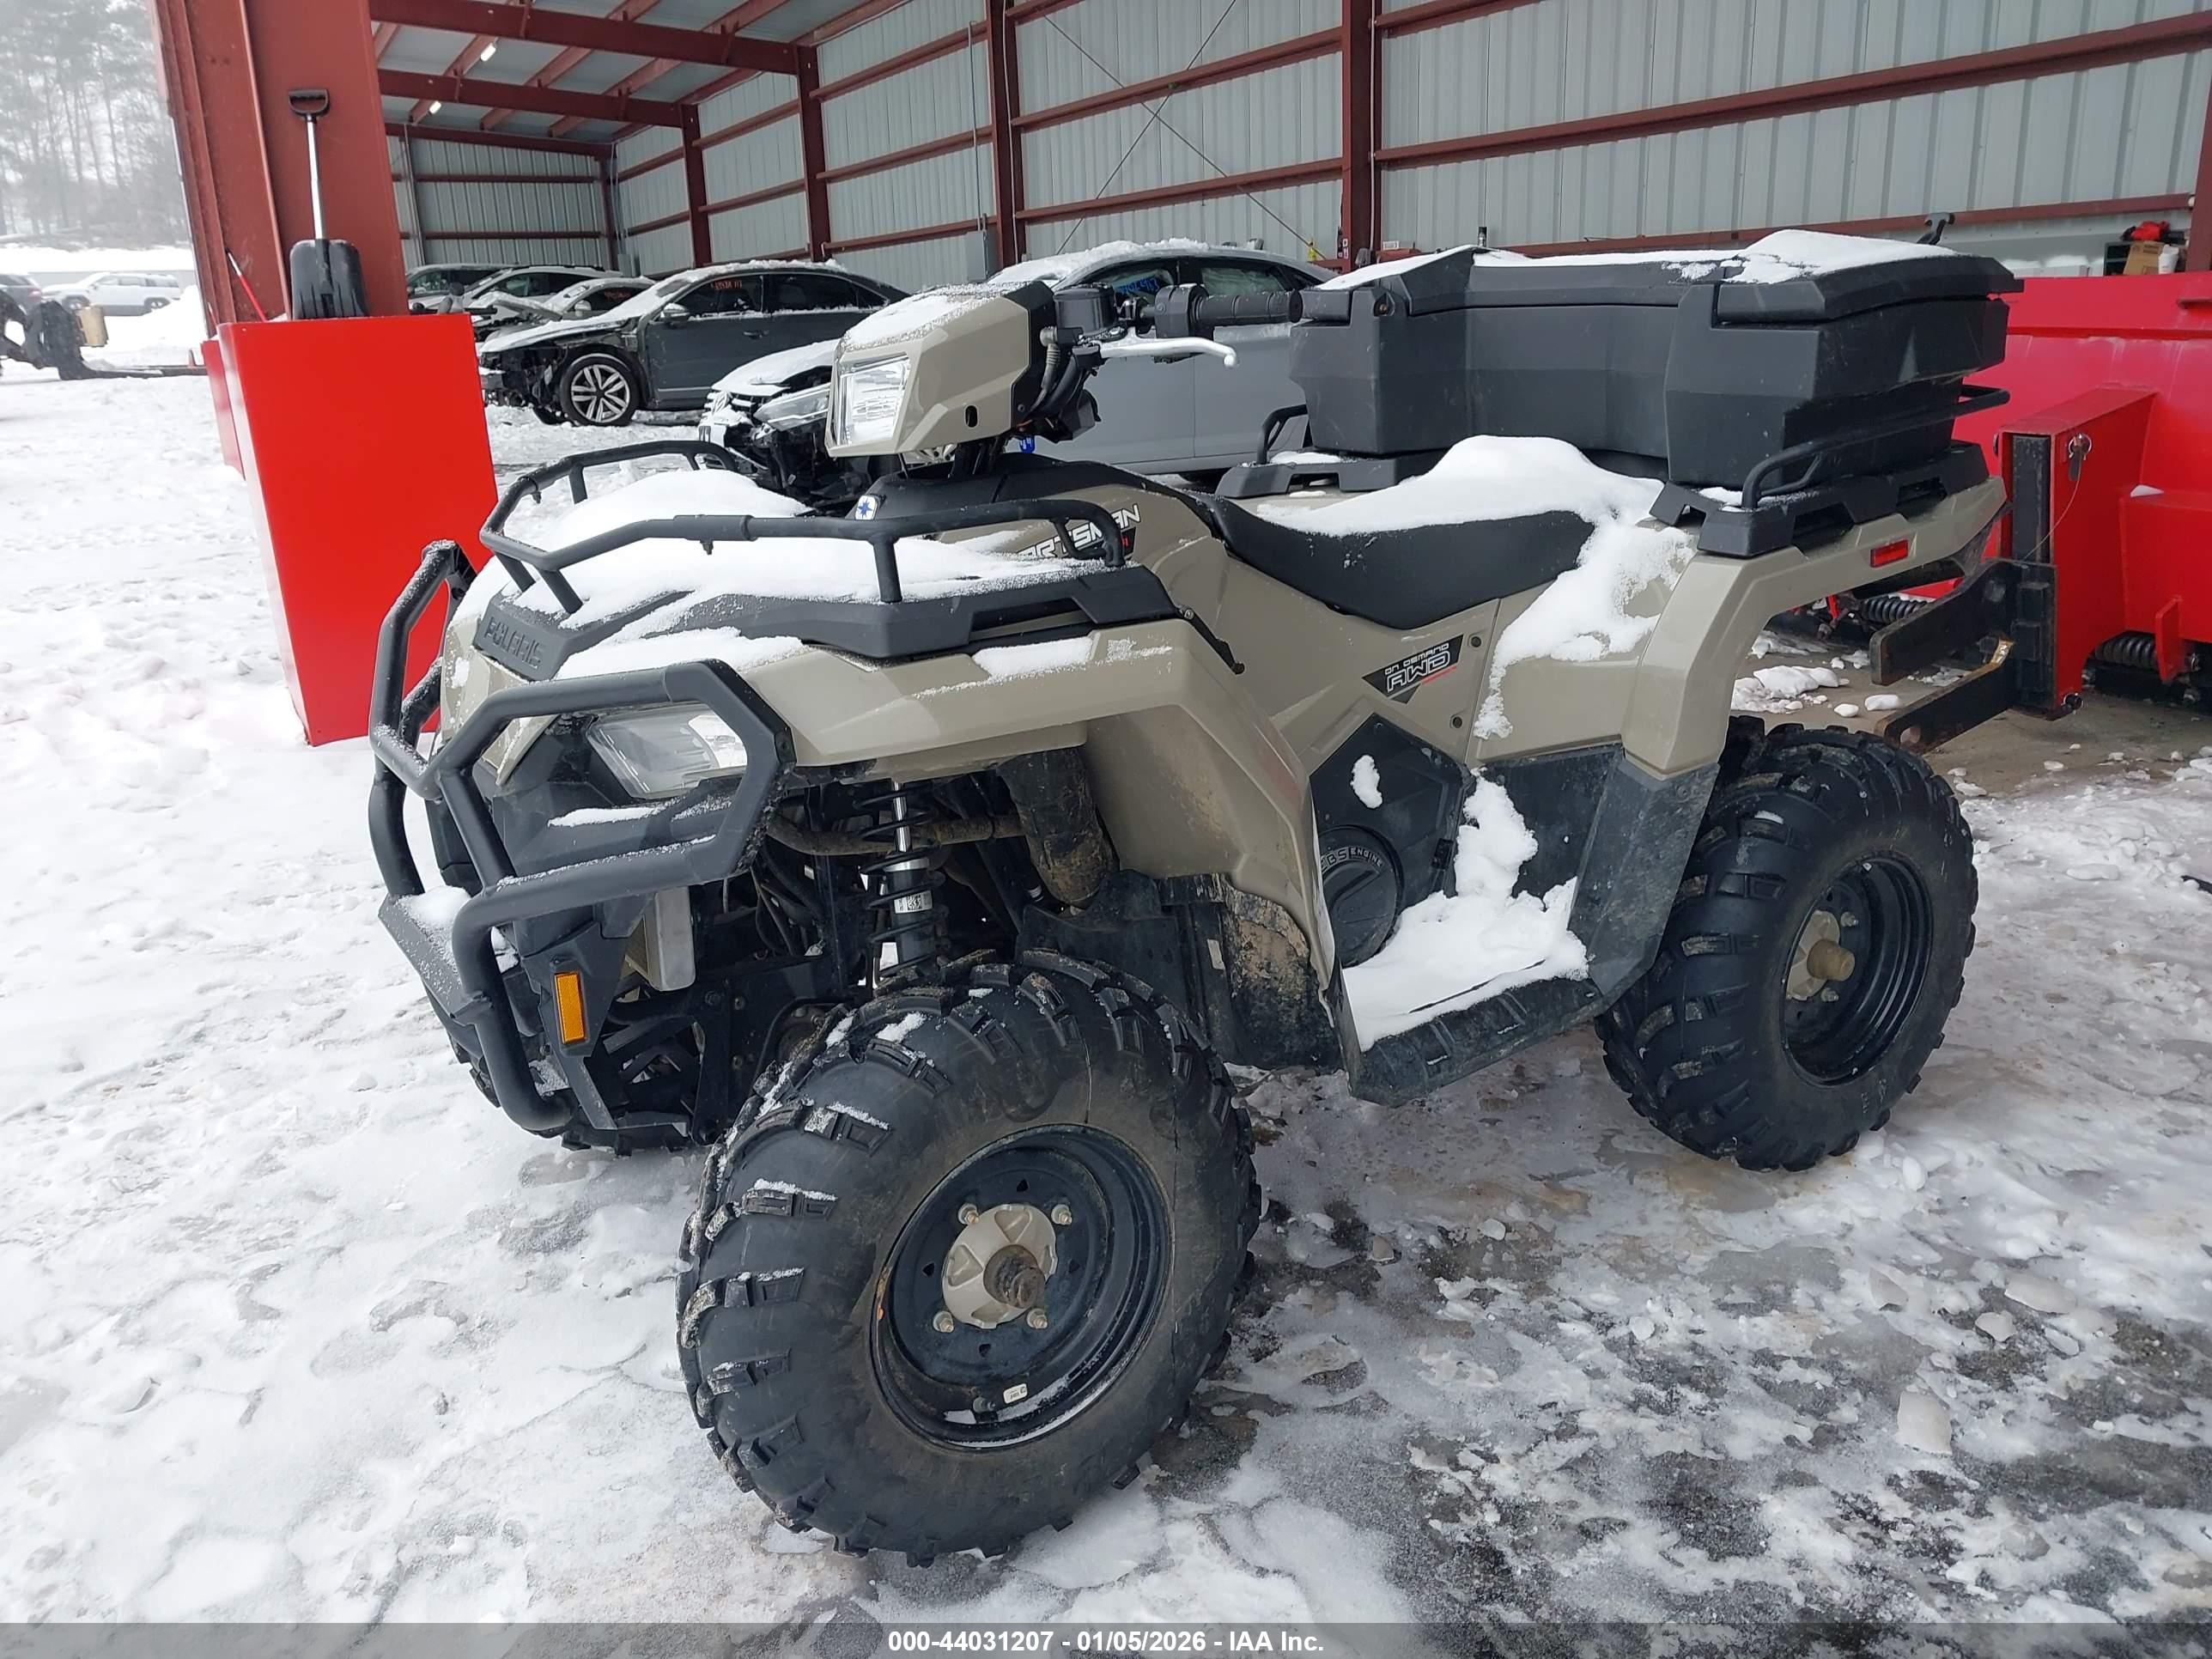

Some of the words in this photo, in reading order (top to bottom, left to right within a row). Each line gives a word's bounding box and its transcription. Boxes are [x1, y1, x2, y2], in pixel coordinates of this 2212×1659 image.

[483, 616, 542, 669] POLARIS
[1384, 664, 1399, 675] ON
[1403, 642, 1449, 666] DEMAND
[1387, 650, 1450, 693] AWD
[1351, 847, 1383, 868] ENGINE
